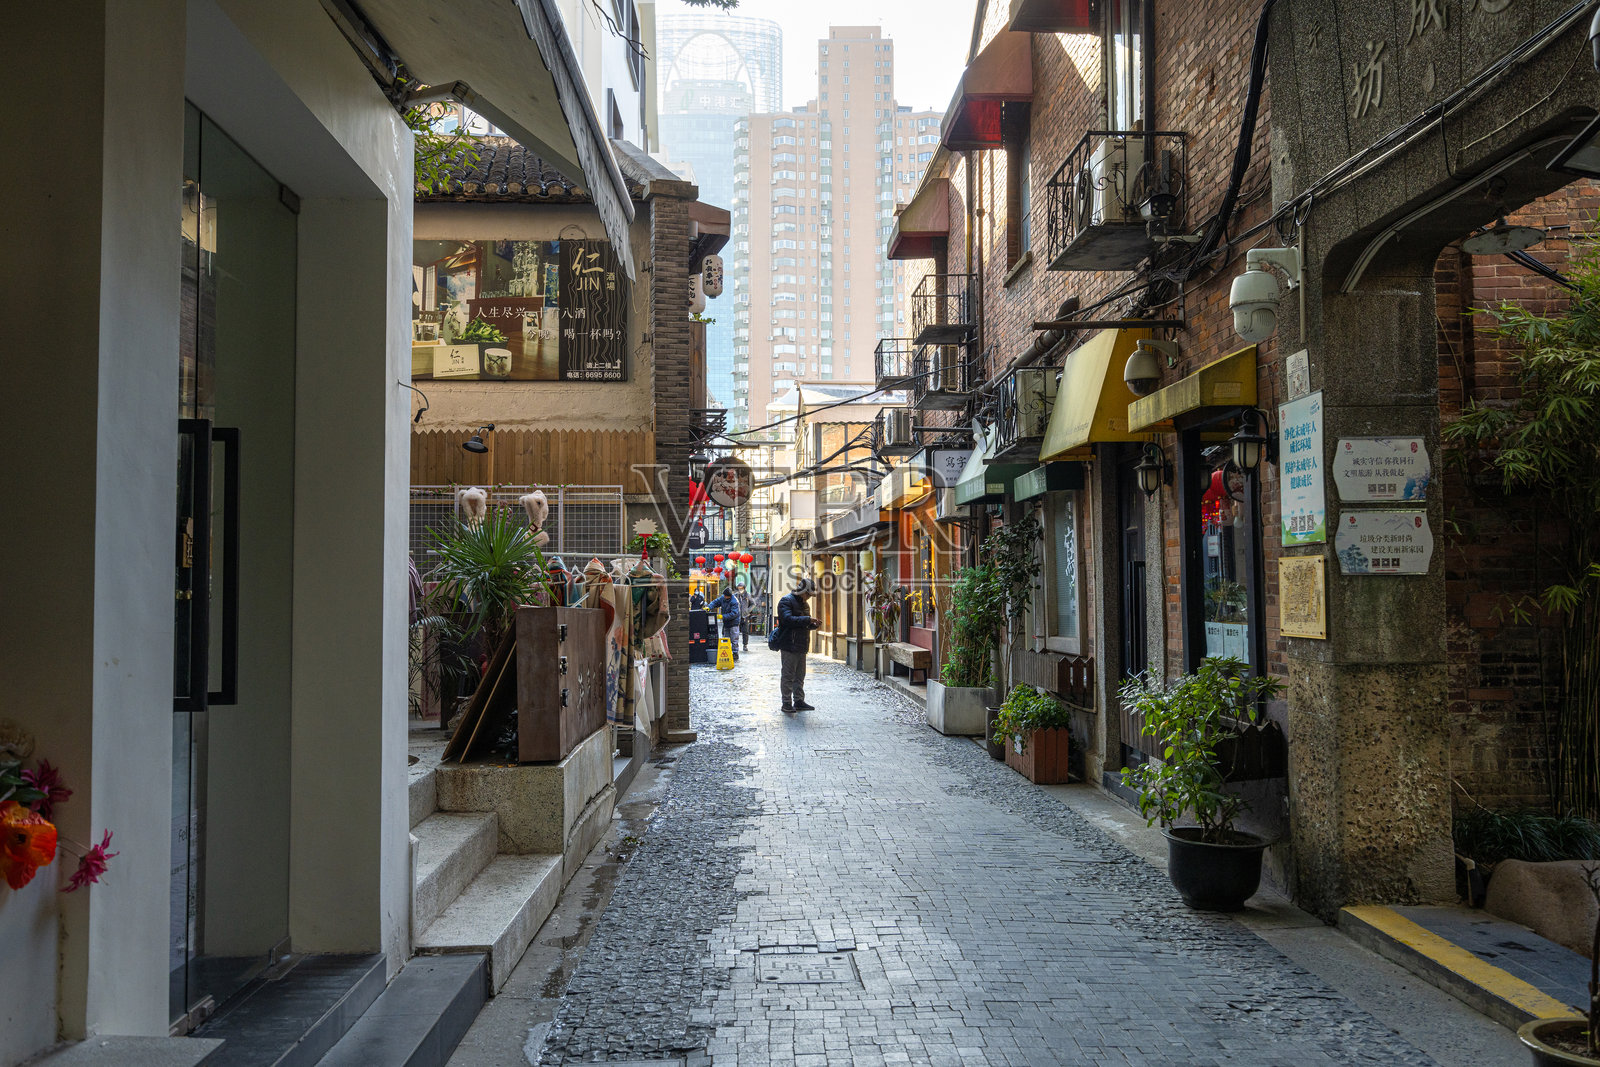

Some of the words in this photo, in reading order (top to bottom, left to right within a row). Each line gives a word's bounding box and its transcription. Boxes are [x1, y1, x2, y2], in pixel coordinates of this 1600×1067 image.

[699, 95, 744, 109] 中港汇
[571, 247, 604, 276] 仁
[576, 276, 600, 291] JIN
[1284, 420, 1317, 440] 净化未成年人
[1289, 437, 1312, 454] 成长环境
[1284, 456, 1317, 475] 保护未成年人
[1343, 469, 1373, 478] 文明旅游
[1290, 474, 1312, 490] 健康成长
[1359, 534, 1413, 543] 垃圾分类新时尚
[1371, 545, 1424, 554] 建设美丽新家园
